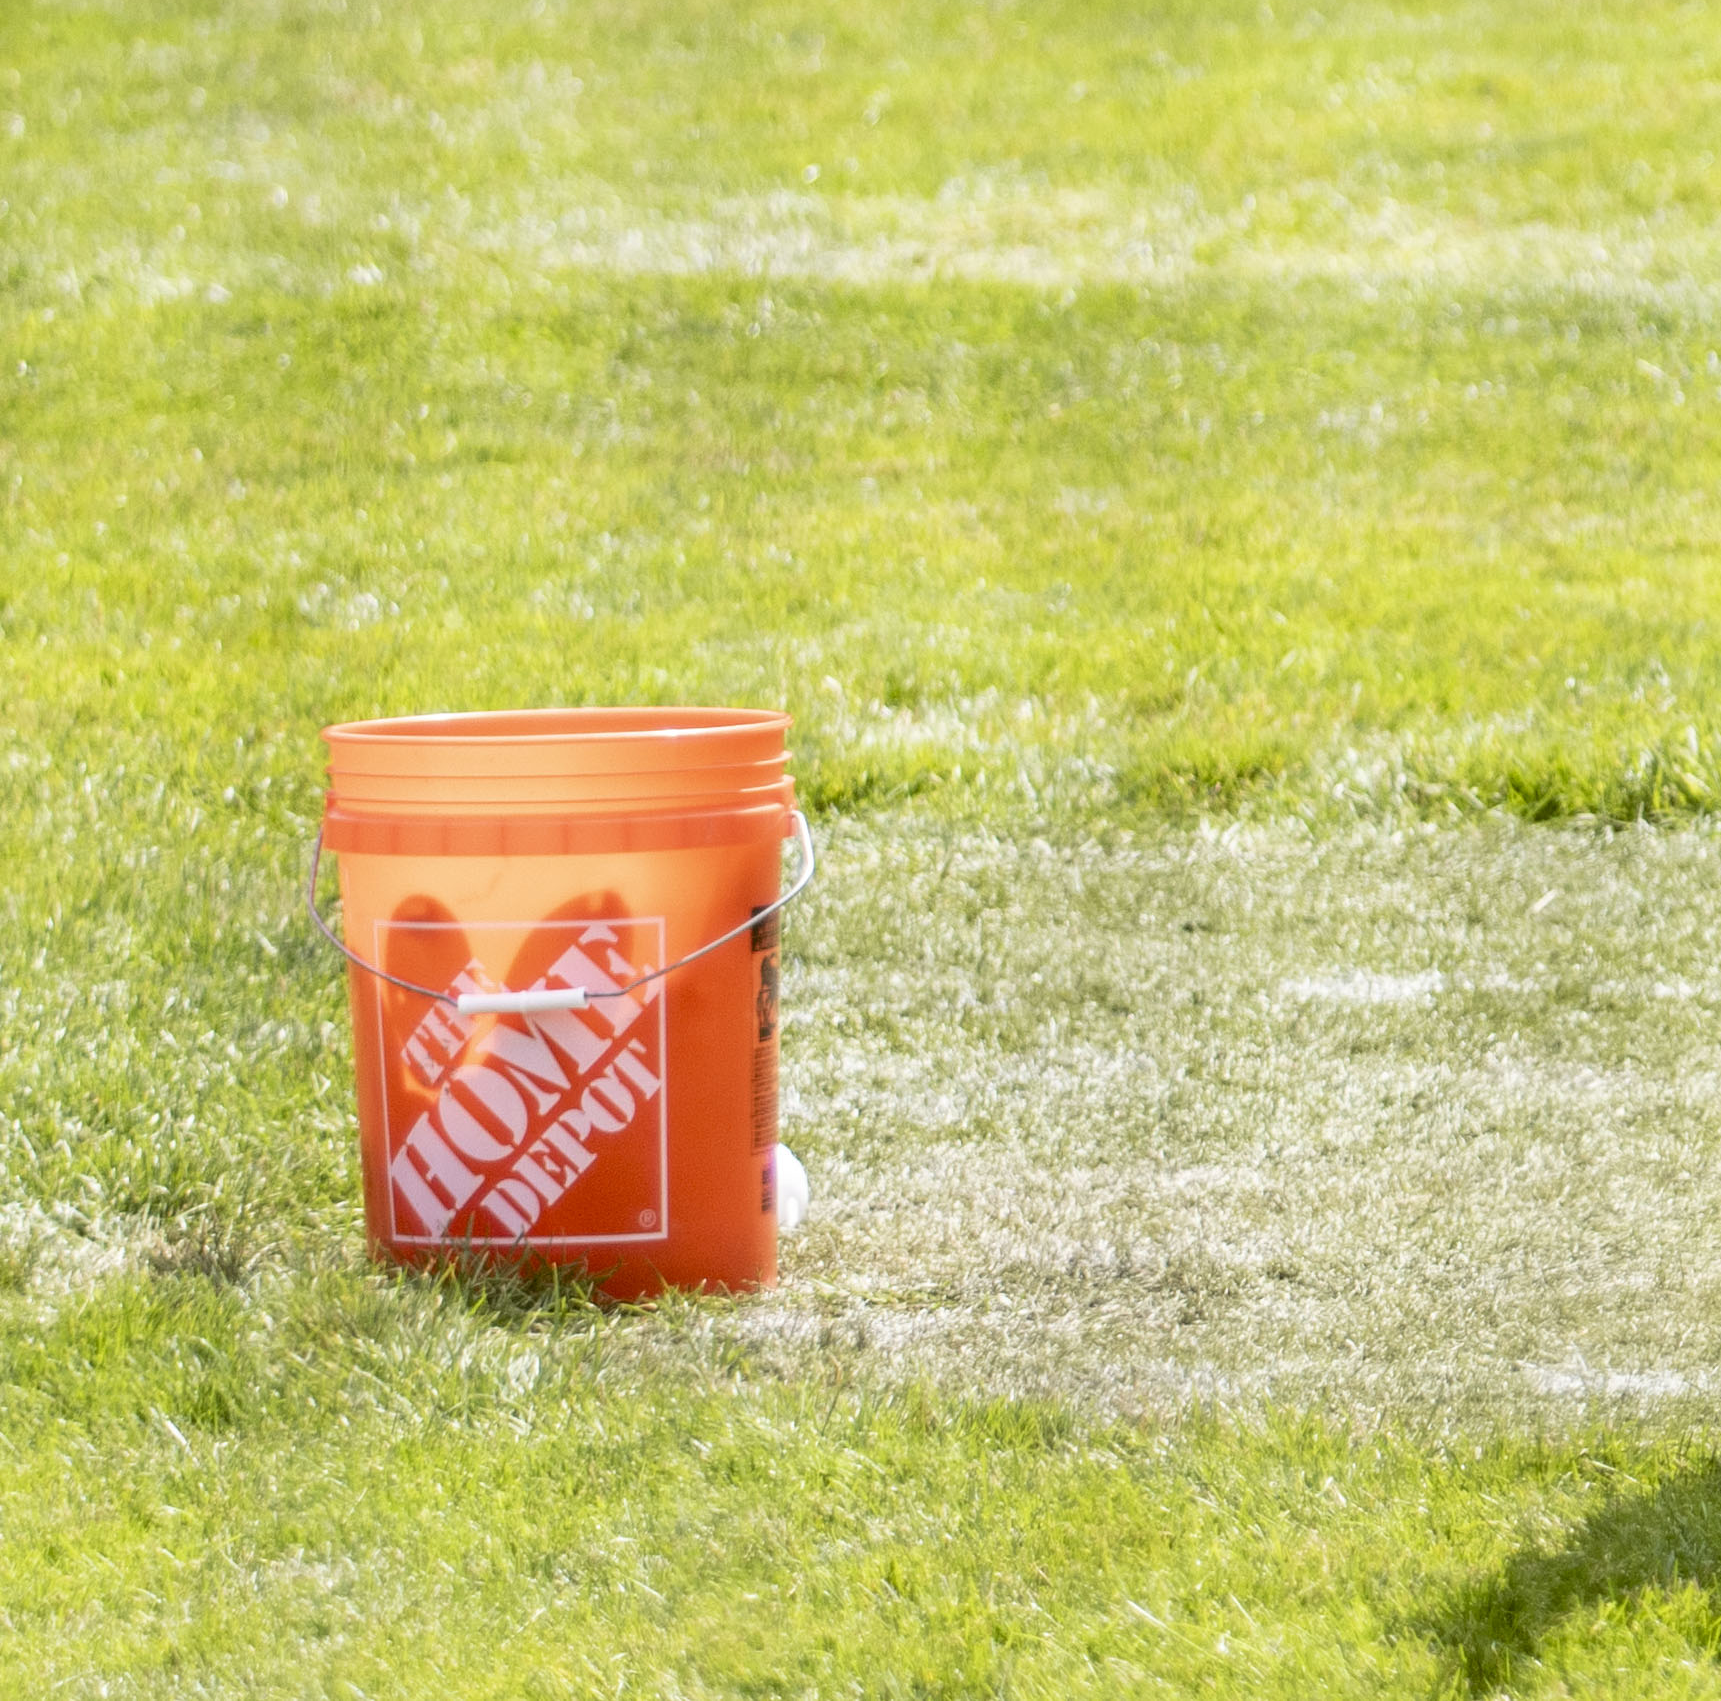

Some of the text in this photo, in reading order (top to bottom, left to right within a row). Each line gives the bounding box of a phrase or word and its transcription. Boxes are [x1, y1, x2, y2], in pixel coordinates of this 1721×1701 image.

[391, 920, 663, 1237] HOME
[401, 956, 508, 1085] THE
[480, 1037, 661, 1237] DEPOT
